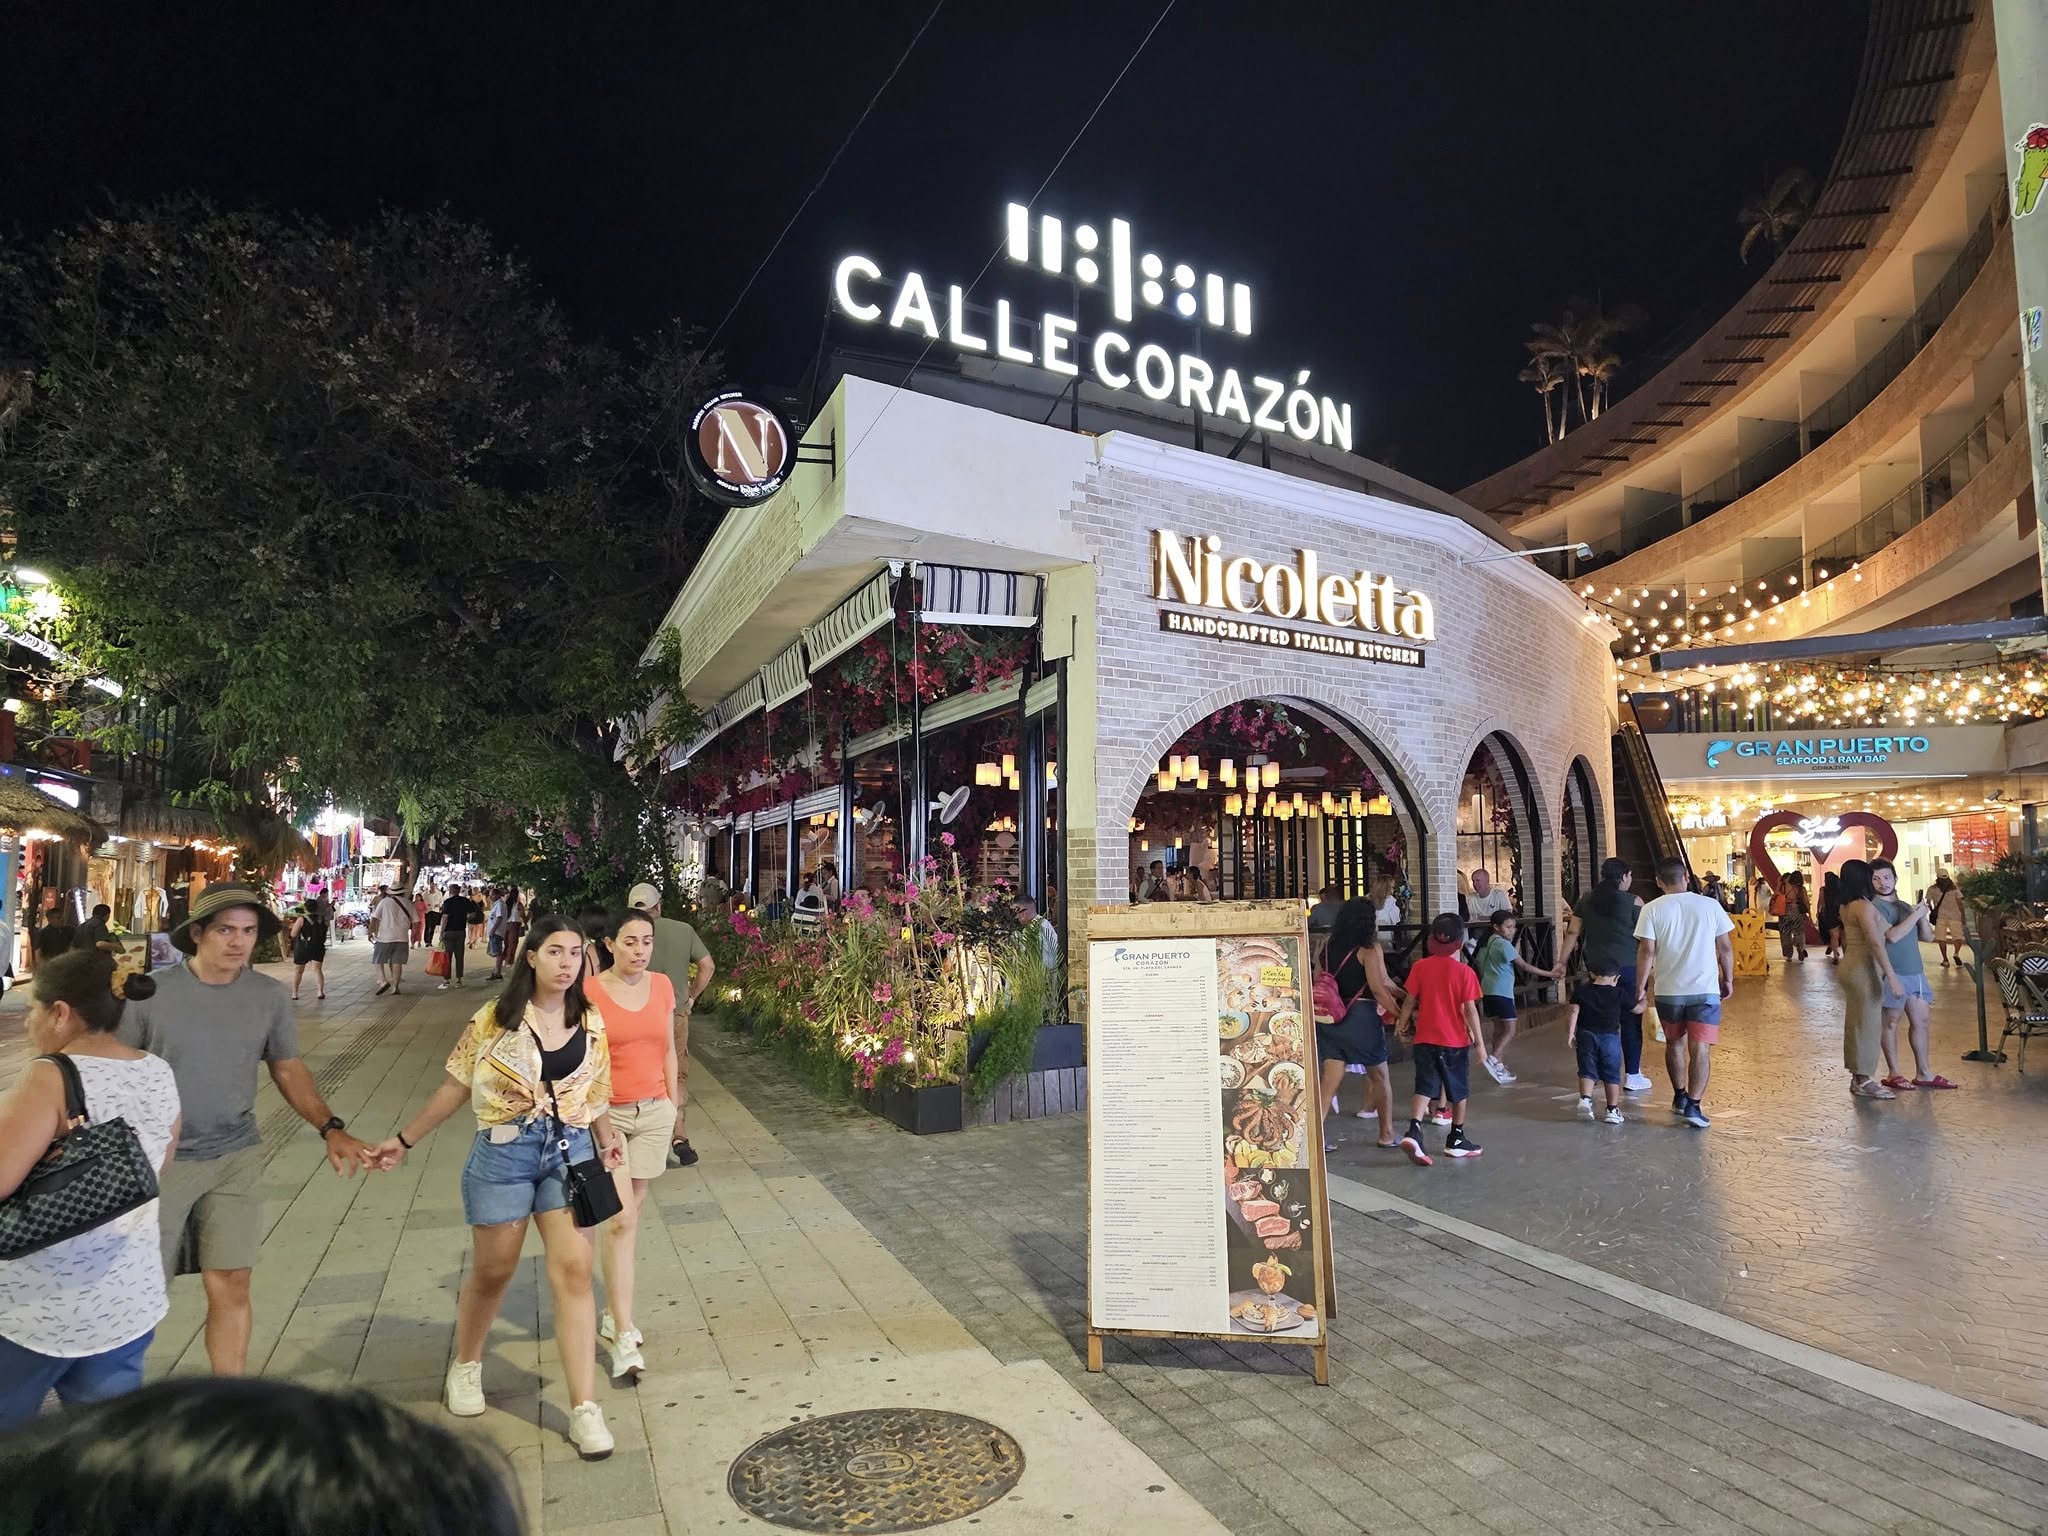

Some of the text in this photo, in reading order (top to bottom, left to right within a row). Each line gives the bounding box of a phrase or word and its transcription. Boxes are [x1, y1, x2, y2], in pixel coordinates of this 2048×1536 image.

[834, 254, 1353, 451] CALLE CORAZÓN
[713, 407, 774, 482] N
[1151, 527, 1438, 643] Nicoletta
[1168, 613, 1420, 665] HANDCRAFTED ITALIAN KITCHEN
[1736, 735, 1930, 757] GRAN PUERTO
[1776, 754, 1888, 766] SEAFOOD & RAW BAR
[1121, 951, 1191, 961] GRAN PUERTO
